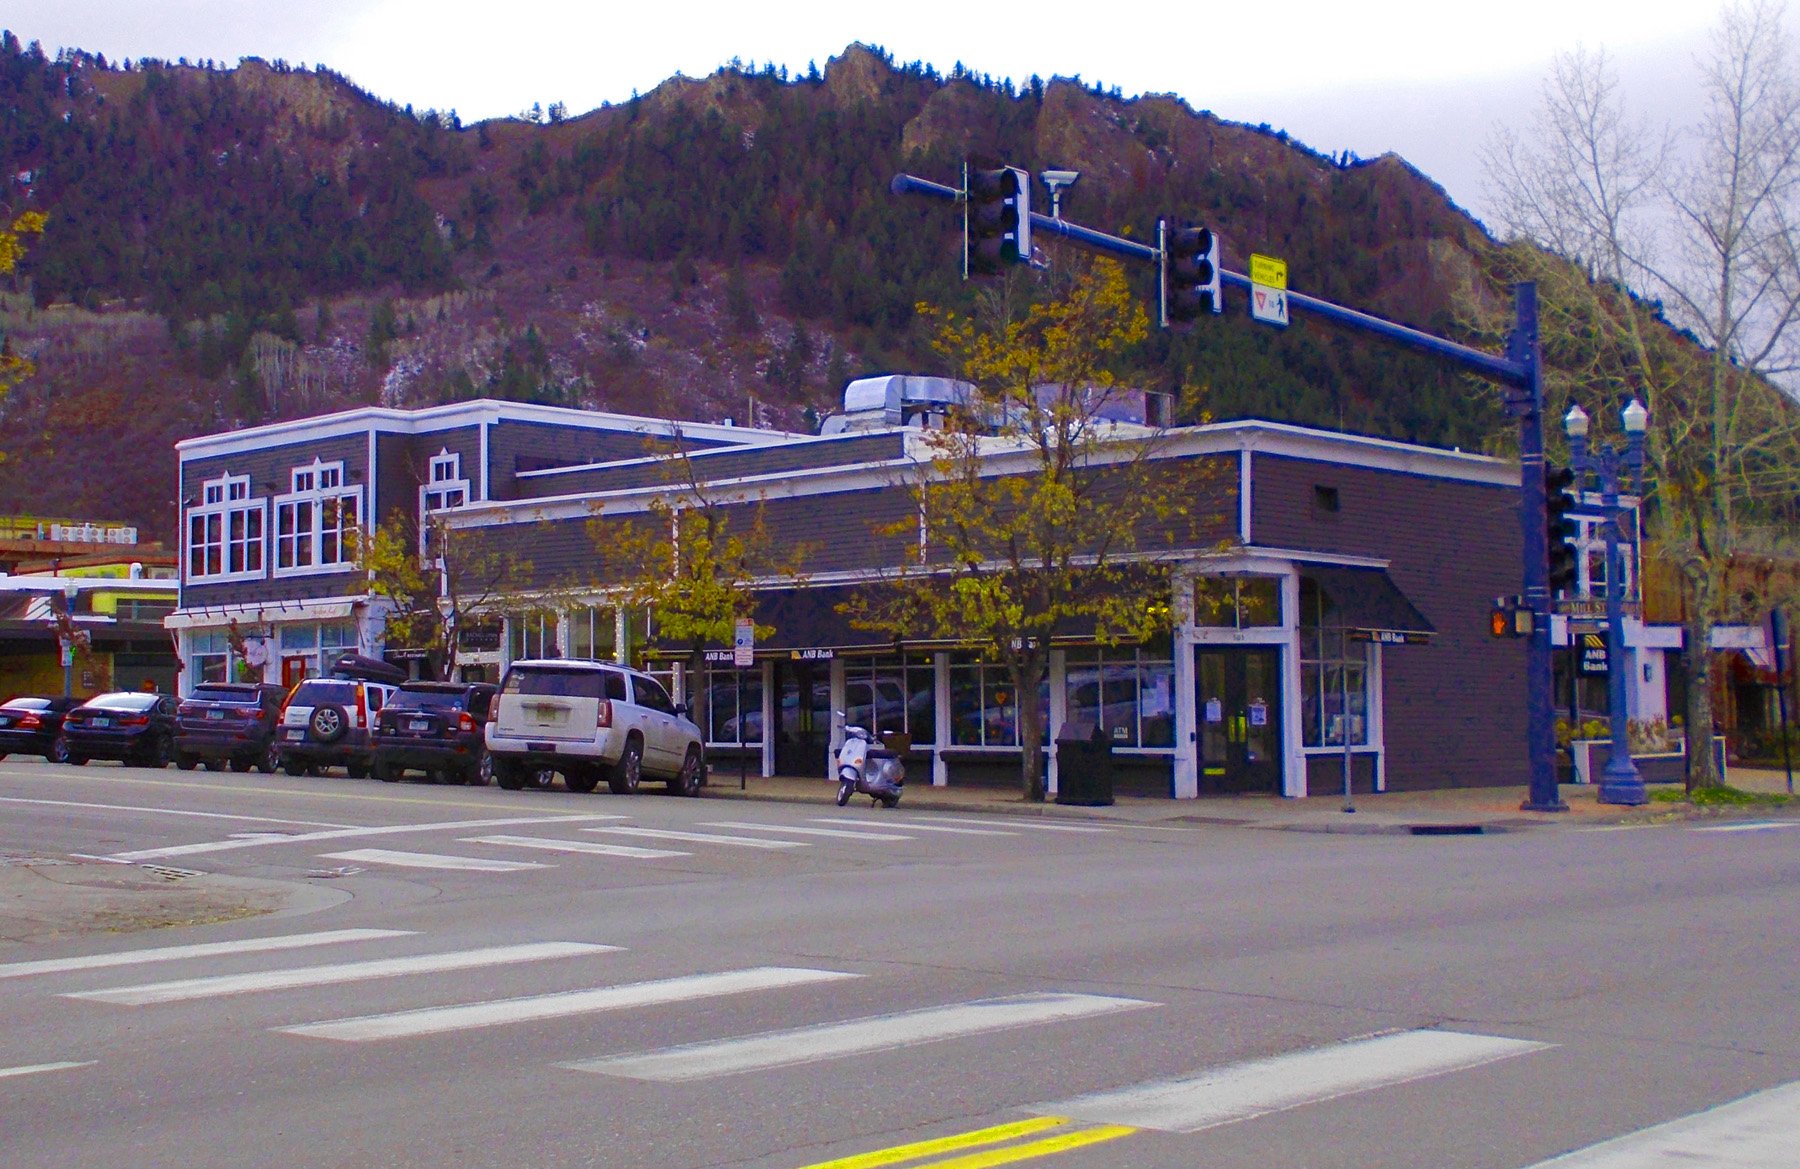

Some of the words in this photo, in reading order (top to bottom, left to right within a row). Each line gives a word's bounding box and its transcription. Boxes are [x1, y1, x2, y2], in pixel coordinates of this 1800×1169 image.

[1571, 602, 1592, 614] MILL
[1381, 632, 1391, 641] ANB
[705, 652, 718, 660] ANB
[720, 651, 733, 660] Bank
[803, 650, 816, 659] ANB
[817, 649, 833, 658] Bank
[1585, 650, 1606, 659] ANB
[1583, 661, 1608, 671] Bank
